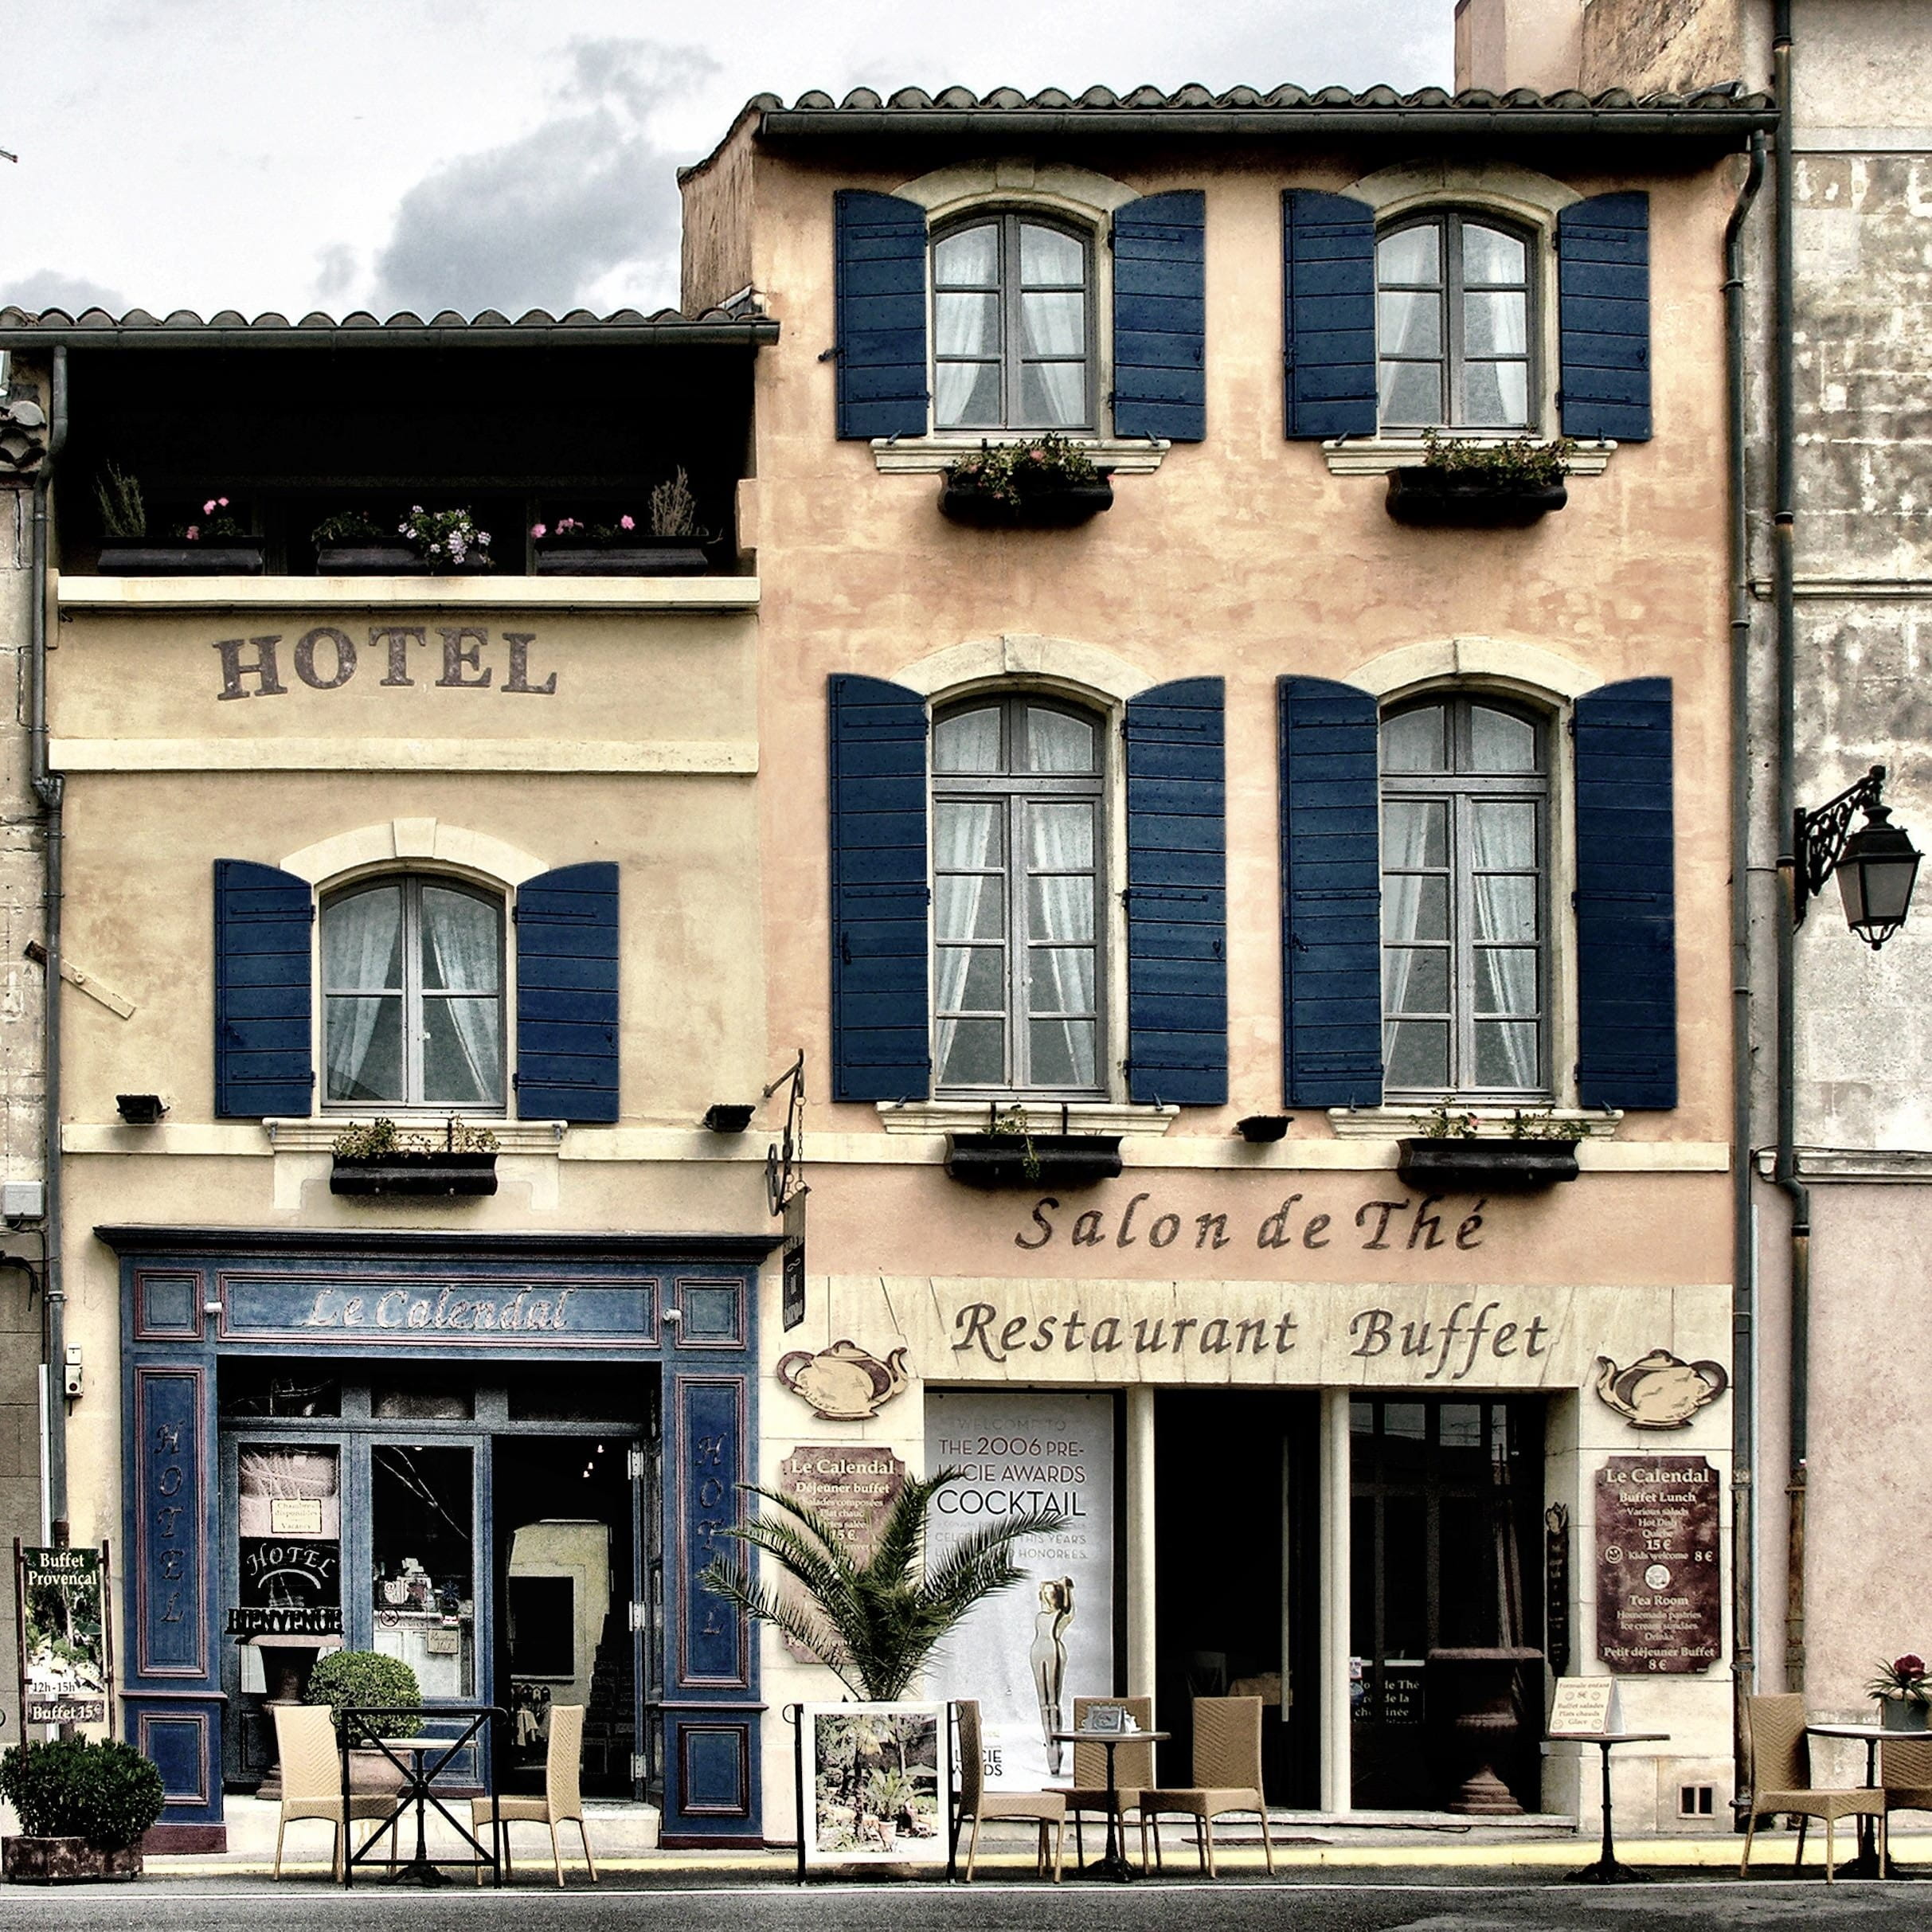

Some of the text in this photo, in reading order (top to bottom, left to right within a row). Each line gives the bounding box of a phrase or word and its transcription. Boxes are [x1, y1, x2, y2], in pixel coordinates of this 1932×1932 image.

[211, 626, 557, 701] HOTEL
[1014, 1192, 1488, 1251] Salon de Thé
[300, 1285, 577, 1330] Le Calendal
[952, 1301, 1549, 1380] Restaurant Buffet
[938, 1437, 1085, 1457] THE 2006 PRE-
[792, 1459, 894, 1475] Le Calendal
[1001, 1465, 1085, 1484] AWARDS
[1606, 1468, 1710, 1484] Le Calendal
[796, 1481, 890, 1496] Déjeuner buffet
[936, 1489, 1086, 1516] COCKTAIL
[1619, 1492, 1696, 1503] Buffet Lunch
[154, 1419, 185, 1623] HOTEL
[1638, 1518, 1656, 1527] Hot
[1646, 1539, 1672, 1551] 15 €
[39, 1552, 84, 1568] Buffet
[246, 1543, 336, 1578] HOTEL
[1694, 1551, 1703, 1562] 8
[1704, 1551, 1713, 1562] €
[28, 1570, 98, 1589] Provençal
[1629, 1594, 1689, 1606] Tea Room
[1604, 1646, 1715, 1659] Petit déjeuner Buffet
[1648, 1659, 1668, 1671] 8 €
[32, 1706, 76, 1721] Buffet
